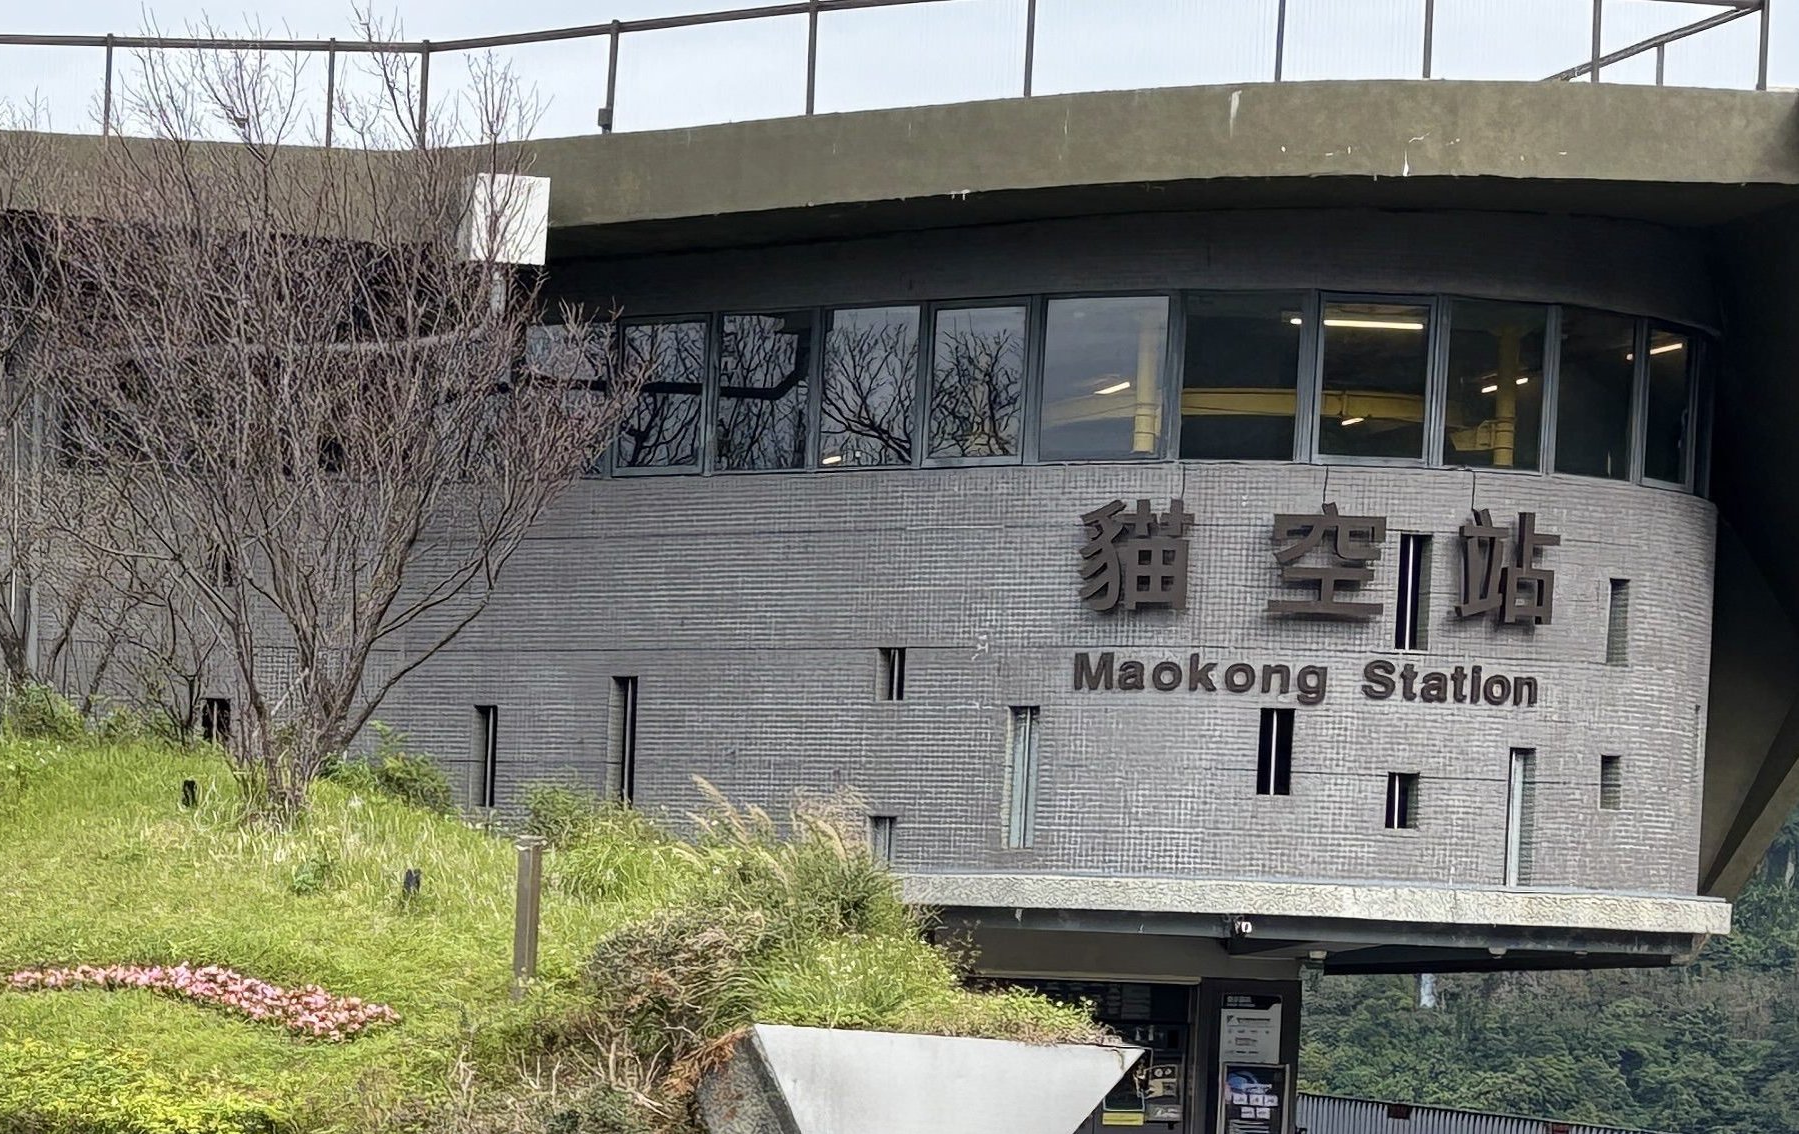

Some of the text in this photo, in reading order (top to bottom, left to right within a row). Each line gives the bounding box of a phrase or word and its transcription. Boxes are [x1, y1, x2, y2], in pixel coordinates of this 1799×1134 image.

[1079, 499, 1561, 625] 貓空站
[1073, 652, 1538, 707] Maokong Station
